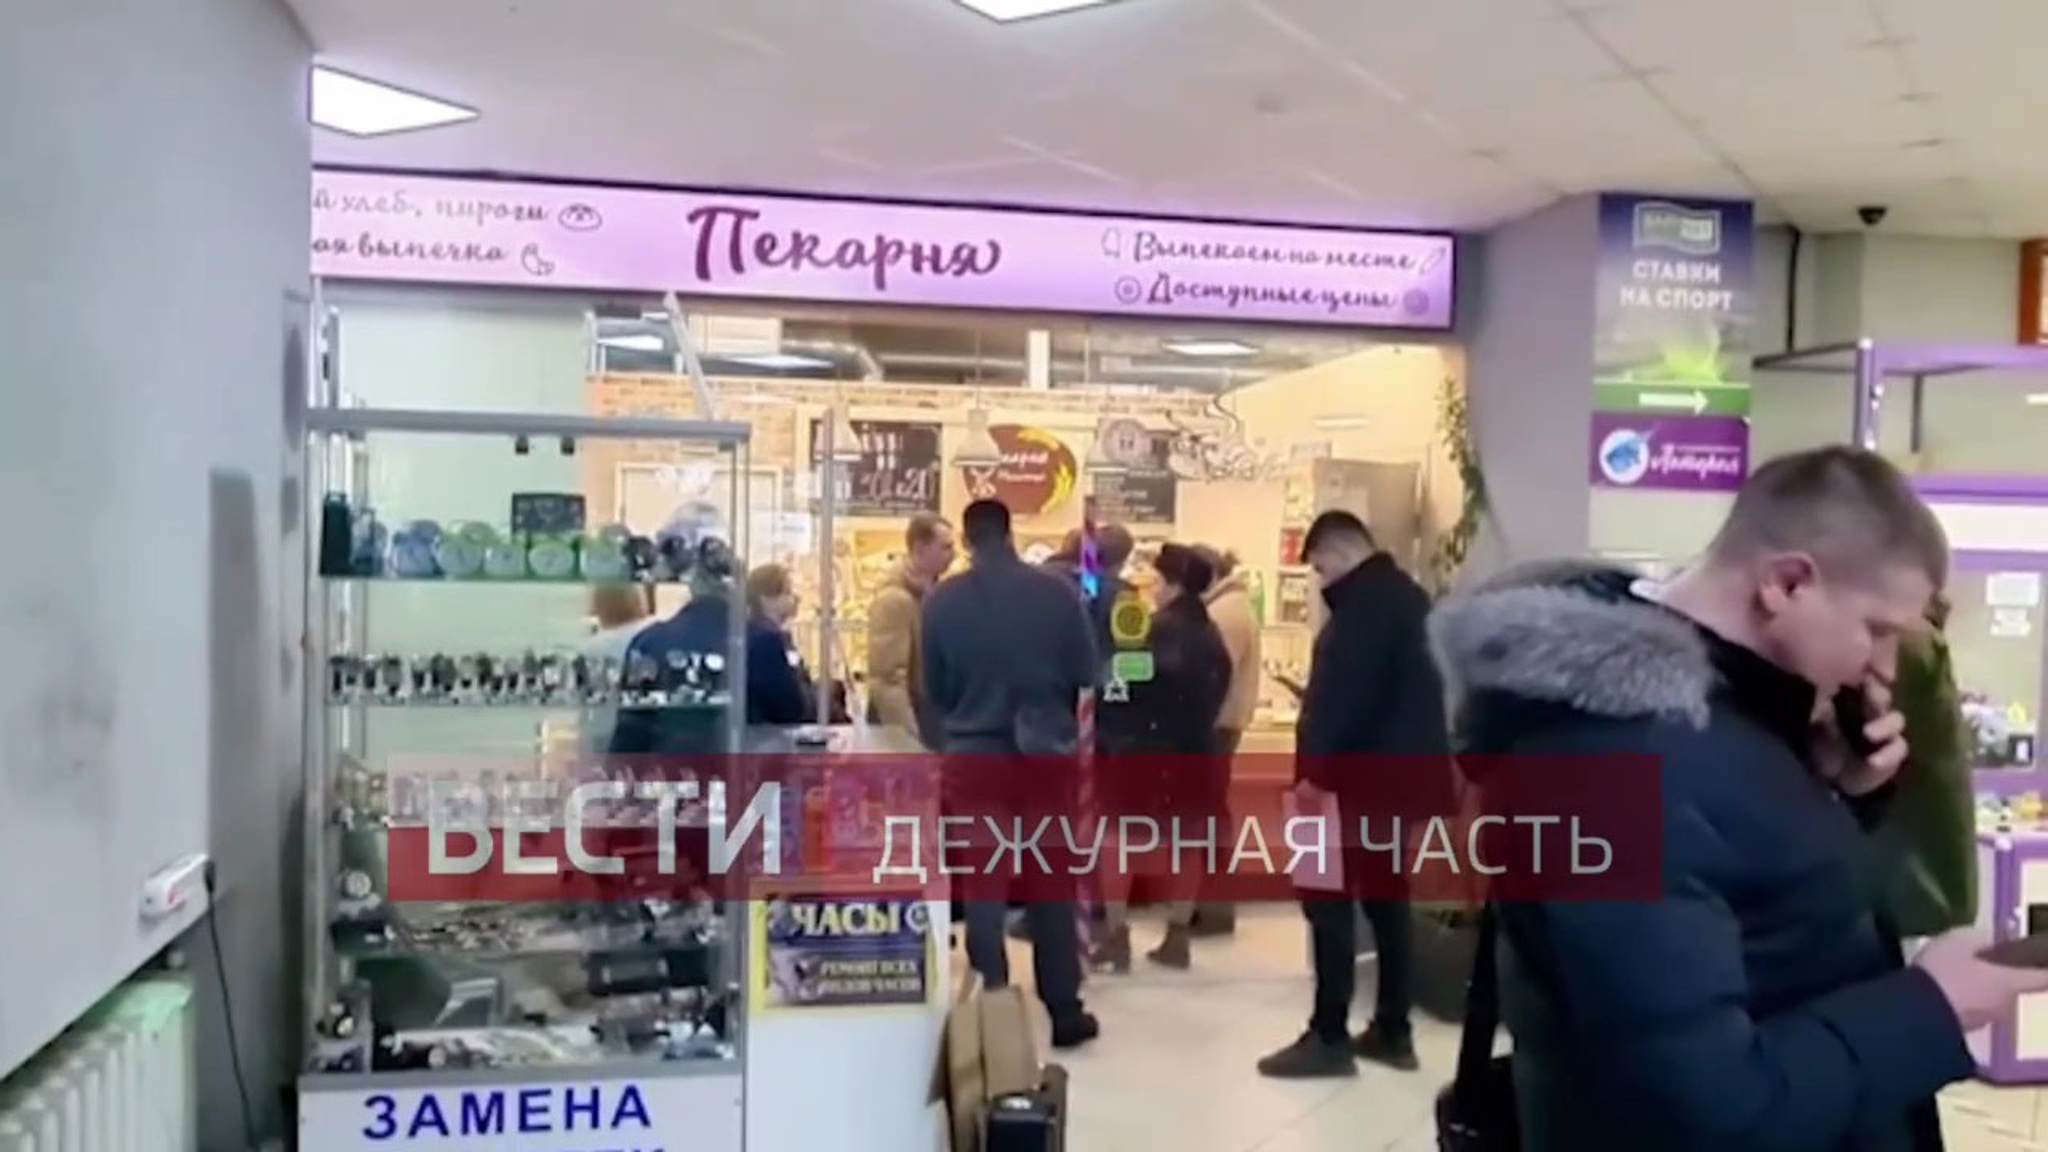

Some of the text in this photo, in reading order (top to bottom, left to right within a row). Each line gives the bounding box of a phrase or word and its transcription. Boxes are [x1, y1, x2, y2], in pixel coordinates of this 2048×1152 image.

[436, 199, 546, 227] пироги
[358, 232, 506, 262] выпечка
[686, 205, 1002, 291] Пекарня
[1133, 230, 1287, 263] Выпекаем
[1324, 251, 1416, 270] месте
[1632, 259, 1721, 284] СТАВКИ
[1147, 271, 1397, 313] Доступные цены
[1619, 286, 1733, 312] НА СПОРТ
[791, 901, 901, 937] ЧАСЫ
[362, 1084, 652, 1141] ЗАМЕНА
